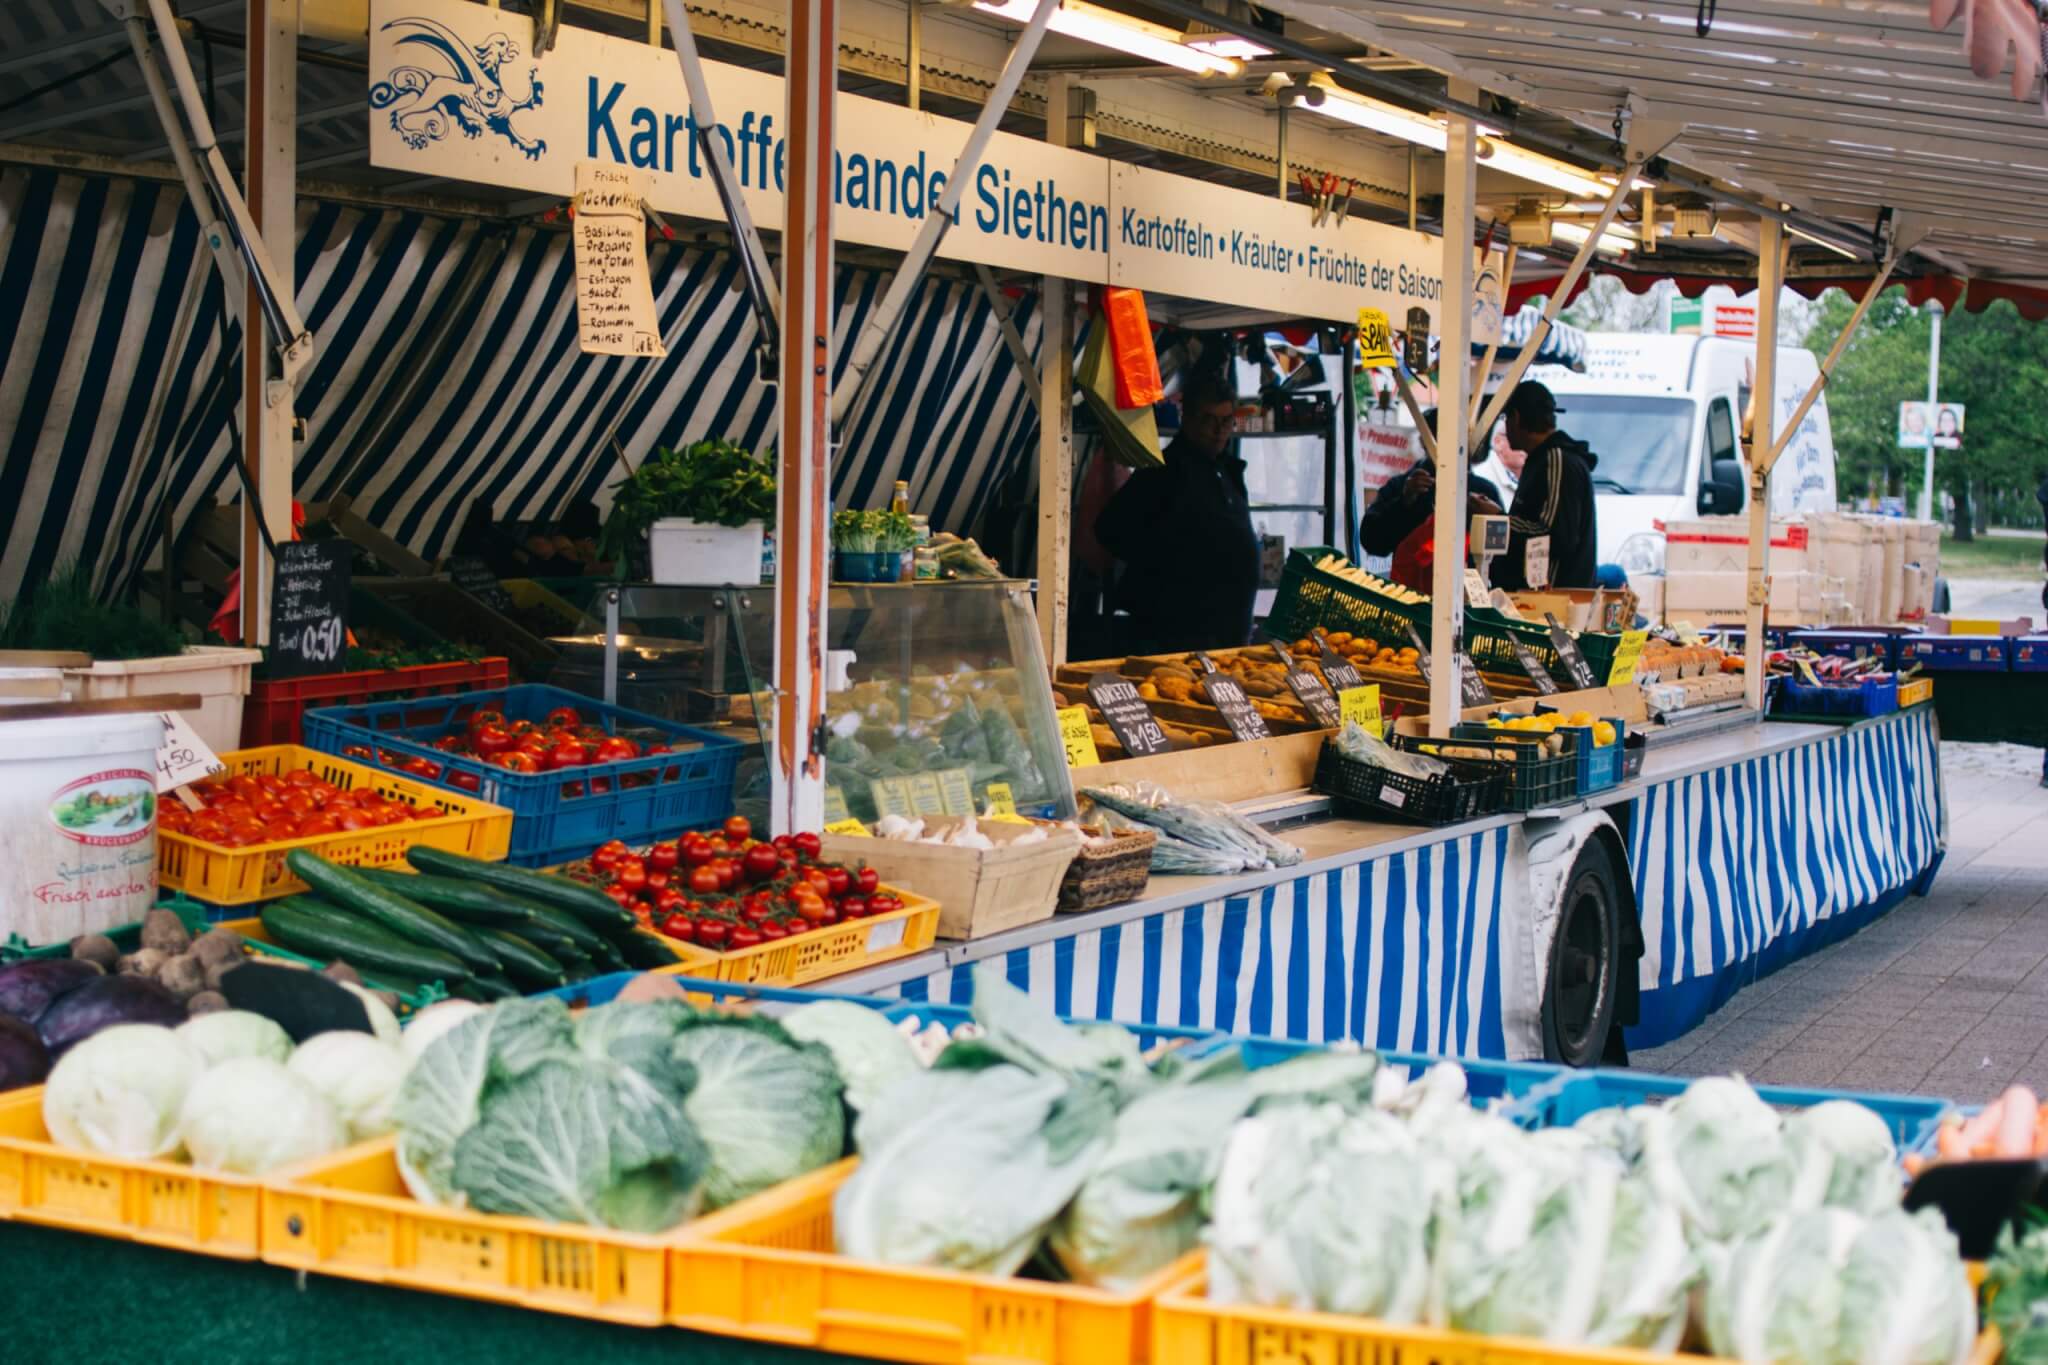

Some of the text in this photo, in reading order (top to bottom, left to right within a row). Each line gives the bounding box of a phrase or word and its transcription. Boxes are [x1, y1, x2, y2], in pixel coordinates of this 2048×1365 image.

[587, 76, 1108, 253] Kartffande Siethen
[594, 170, 630, 185] Frische
[1122, 206, 1442, 301] Kartoffeln Kräuter Früchte der Saison
[90, 768, 143, 784] ORIGINAL
